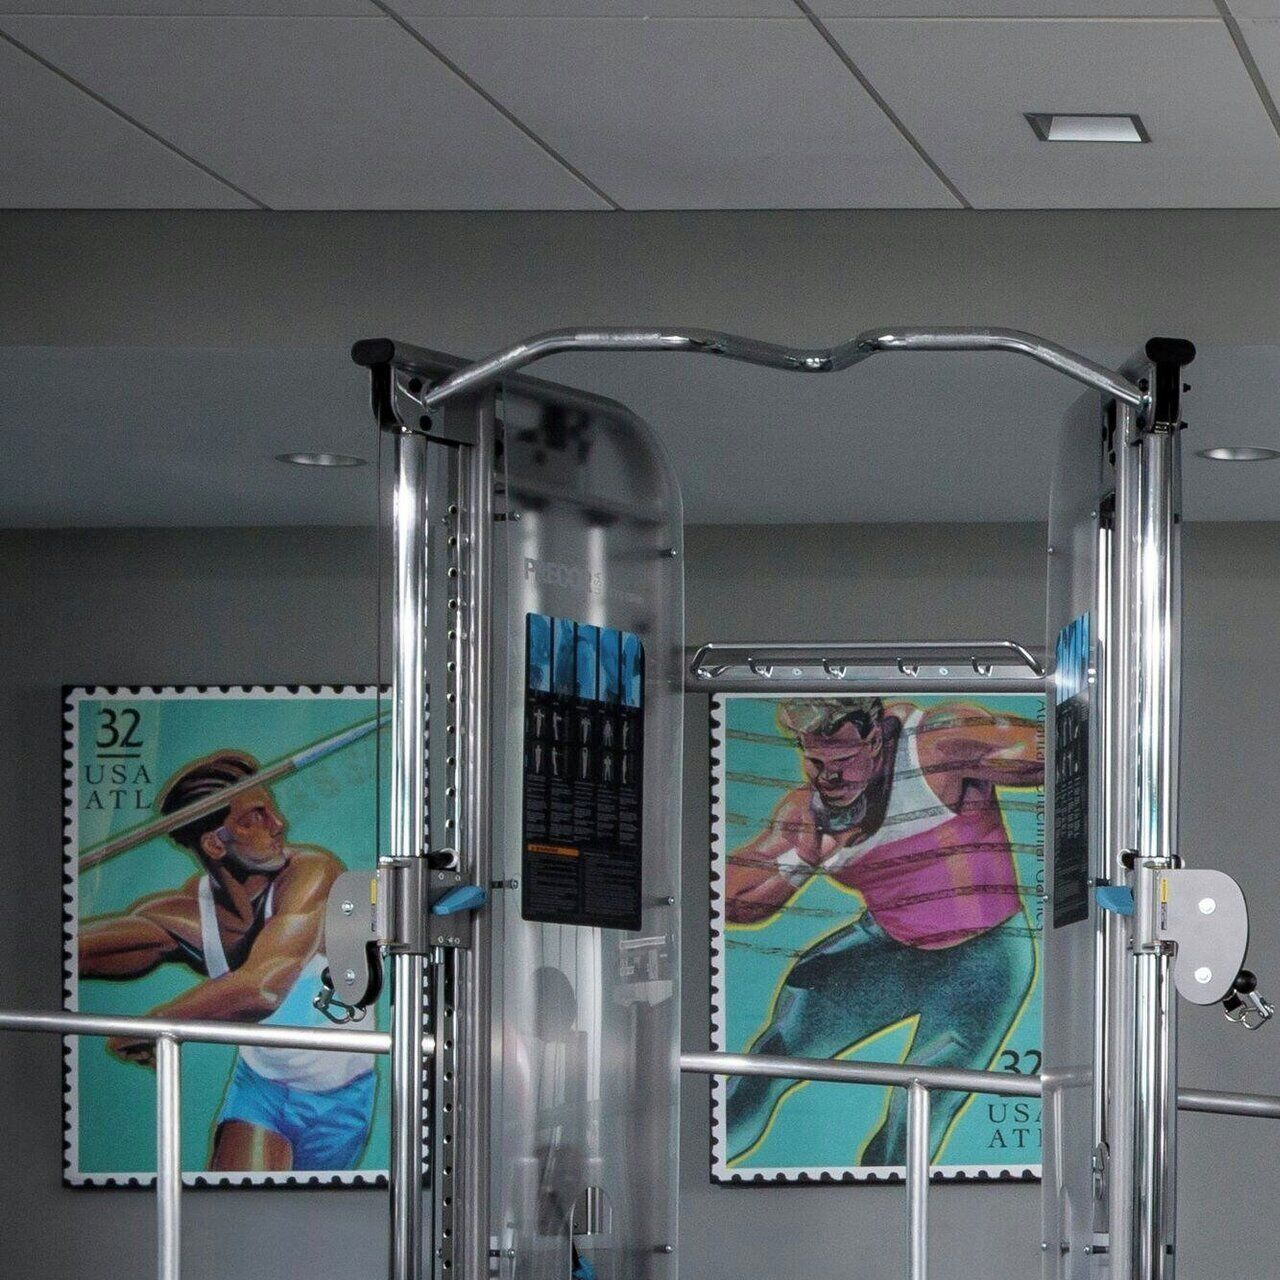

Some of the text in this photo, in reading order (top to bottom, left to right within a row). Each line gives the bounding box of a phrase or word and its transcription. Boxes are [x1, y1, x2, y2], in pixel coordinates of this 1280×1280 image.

[96, 708, 143, 748] 32
[85, 764, 152, 784] USA
[85, 790, 152, 809] ATL
[987, 1129, 1042, 1148] AT
